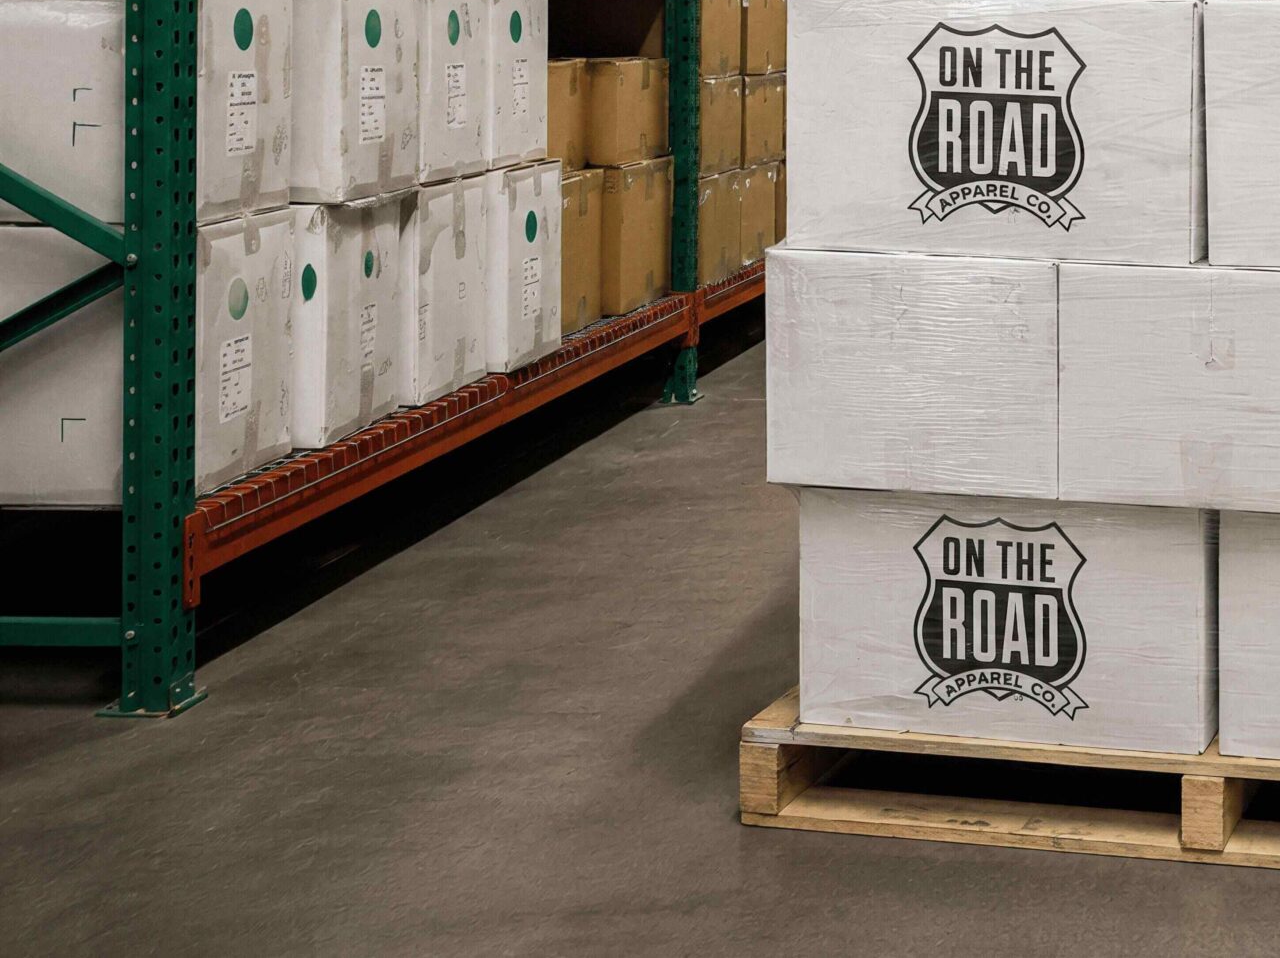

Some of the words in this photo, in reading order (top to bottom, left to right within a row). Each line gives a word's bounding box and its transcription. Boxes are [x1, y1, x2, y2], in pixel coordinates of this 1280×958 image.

[939, 45, 983, 88] ON
[994, 48, 1055, 91] THE
[938, 98, 1057, 178] ROAD
[938, 183, 1020, 213] APPAREL
[942, 536, 985, 578] ON
[996, 540, 1056, 583] THE
[942, 586, 1059, 667] ROAD
[944, 671, 1023, 698] APPAREL
[1030, 682, 1056, 709] CO.
